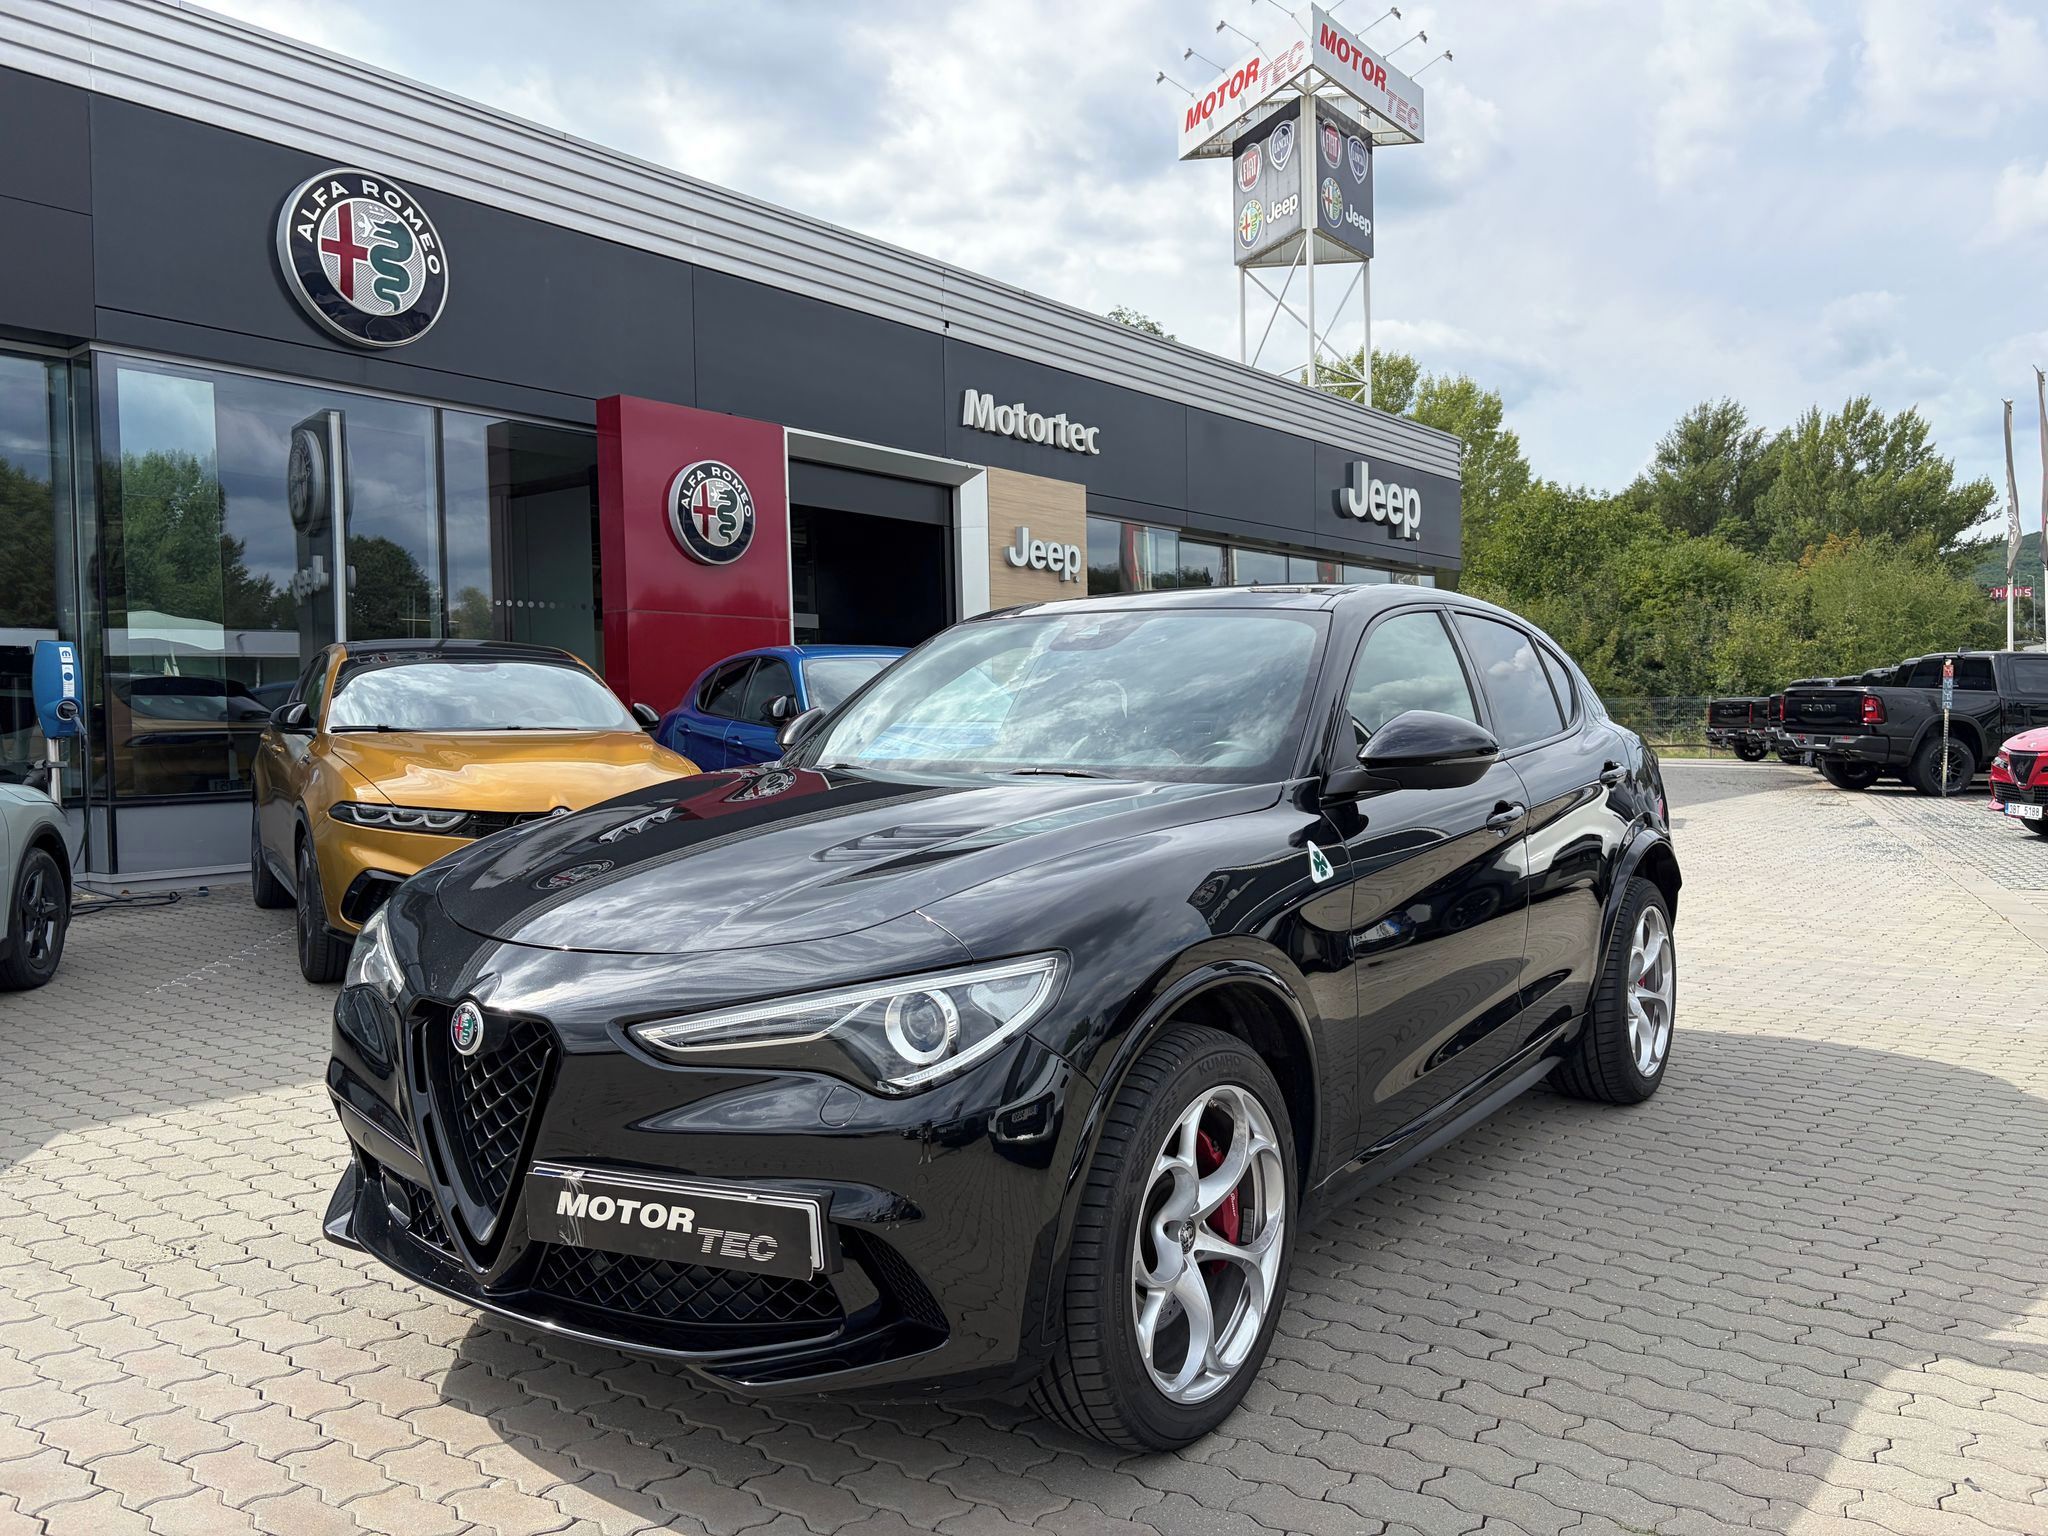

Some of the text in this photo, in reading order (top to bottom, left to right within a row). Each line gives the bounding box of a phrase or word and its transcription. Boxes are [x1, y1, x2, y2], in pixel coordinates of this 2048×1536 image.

[1184, 40, 1305, 133] MOTOR TEC
[1320, 23, 1420, 131] MOTOR TEC
[1243, 154, 1257, 182] FIAT
[297, 179, 441, 275] ALFA ROMEO
[1266, 193, 1298, 224] Jeep
[1345, 204, 1371, 236] Jeep
[962, 388, 1100, 455] Motortec
[681, 466, 752, 517] ALFA ROMEO
[1341, 461, 1421, 540] Jeep
[1006, 526, 1081, 582] Jeep
[556, 1190, 779, 1262] MOTOR TEC
